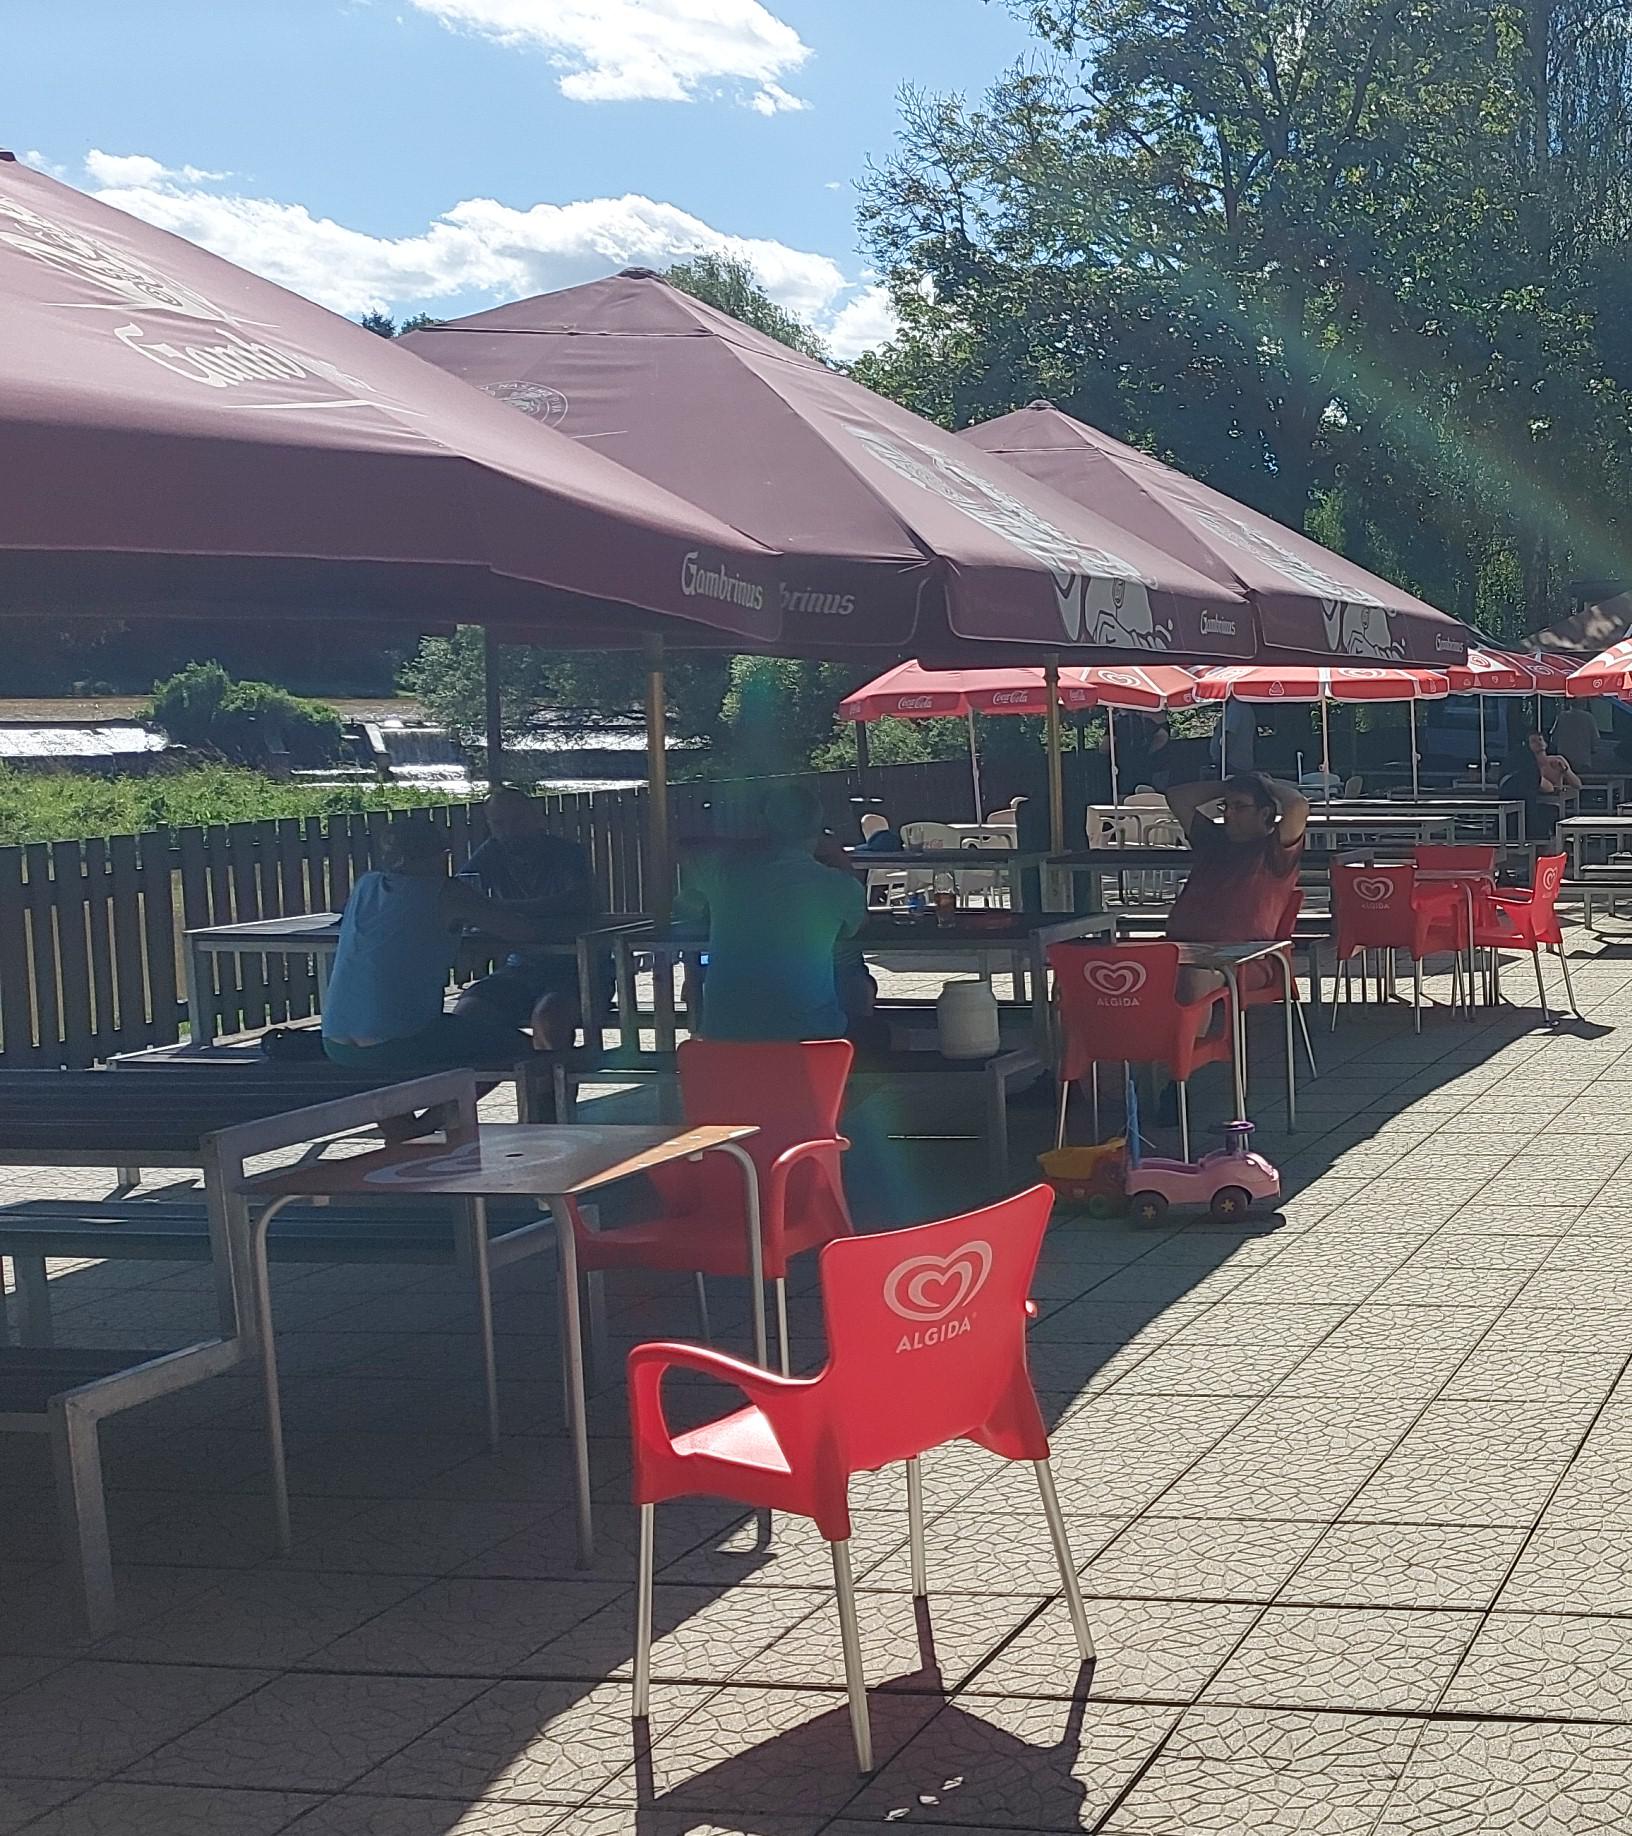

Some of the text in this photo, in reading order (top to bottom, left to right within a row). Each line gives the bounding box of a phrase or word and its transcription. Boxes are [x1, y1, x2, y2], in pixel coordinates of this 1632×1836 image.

[681, 551, 764, 611] Gambrinus
[779, 581, 856, 615] brinus
[992, 689, 1029, 704] Coca-Cola
[1096, 997, 1140, 1007] ALGIDA
[896, 1316, 971, 1353] ALGIDA
